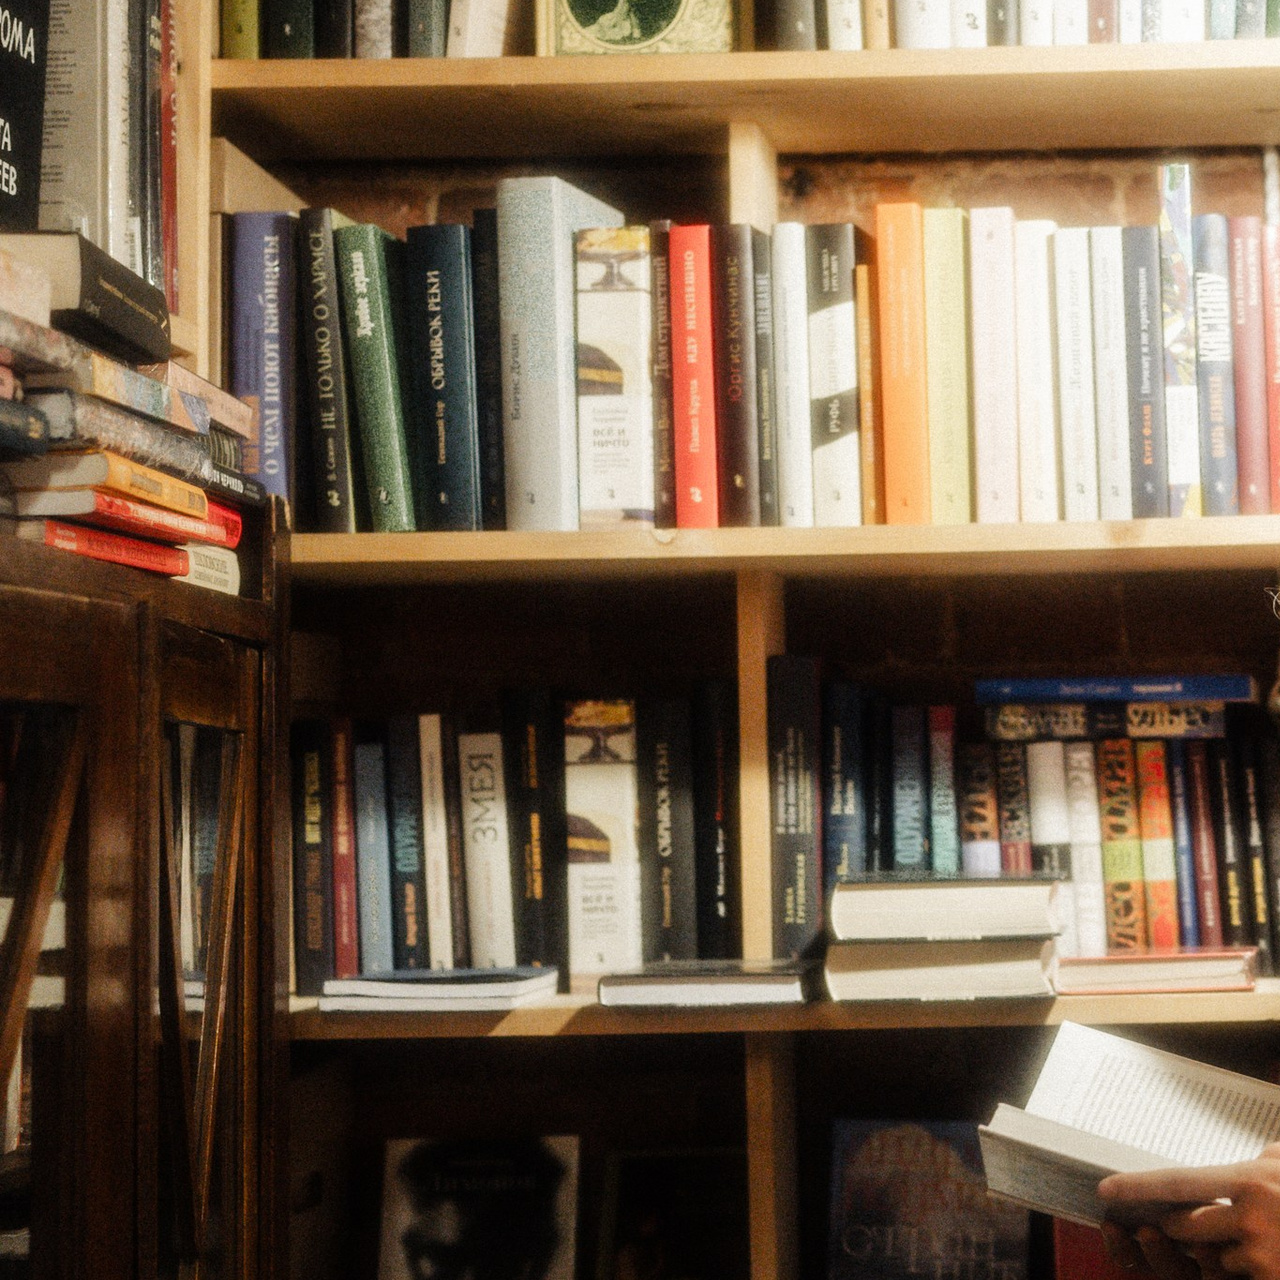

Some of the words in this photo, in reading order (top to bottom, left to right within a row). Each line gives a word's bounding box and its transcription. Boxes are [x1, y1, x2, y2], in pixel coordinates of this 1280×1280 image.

[308, 226, 328, 300] ХАРМСЕ
[425, 269, 442, 312] РЕКИ
[684, 250, 697, 332] НЕСПЕШНО
[312, 304, 331, 322] О
[726, 255, 742, 339] Кунчинас
[263, 341, 279, 403] поют
[314, 326, 335, 400] ТОЛЬКО
[428, 315, 446, 391] ОБРЫВОК
[687, 336, 698, 364] ИДУ
[728, 343, 744, 402] Юргис
[321, 406, 337, 430] НЕ
[510, 382, 522, 422] Борис
[592, 439, 630, 448] НИЧТО
[1143, 440, 1153, 466] КУРТ
[465, 752, 498, 844] ЗМЕЯ
